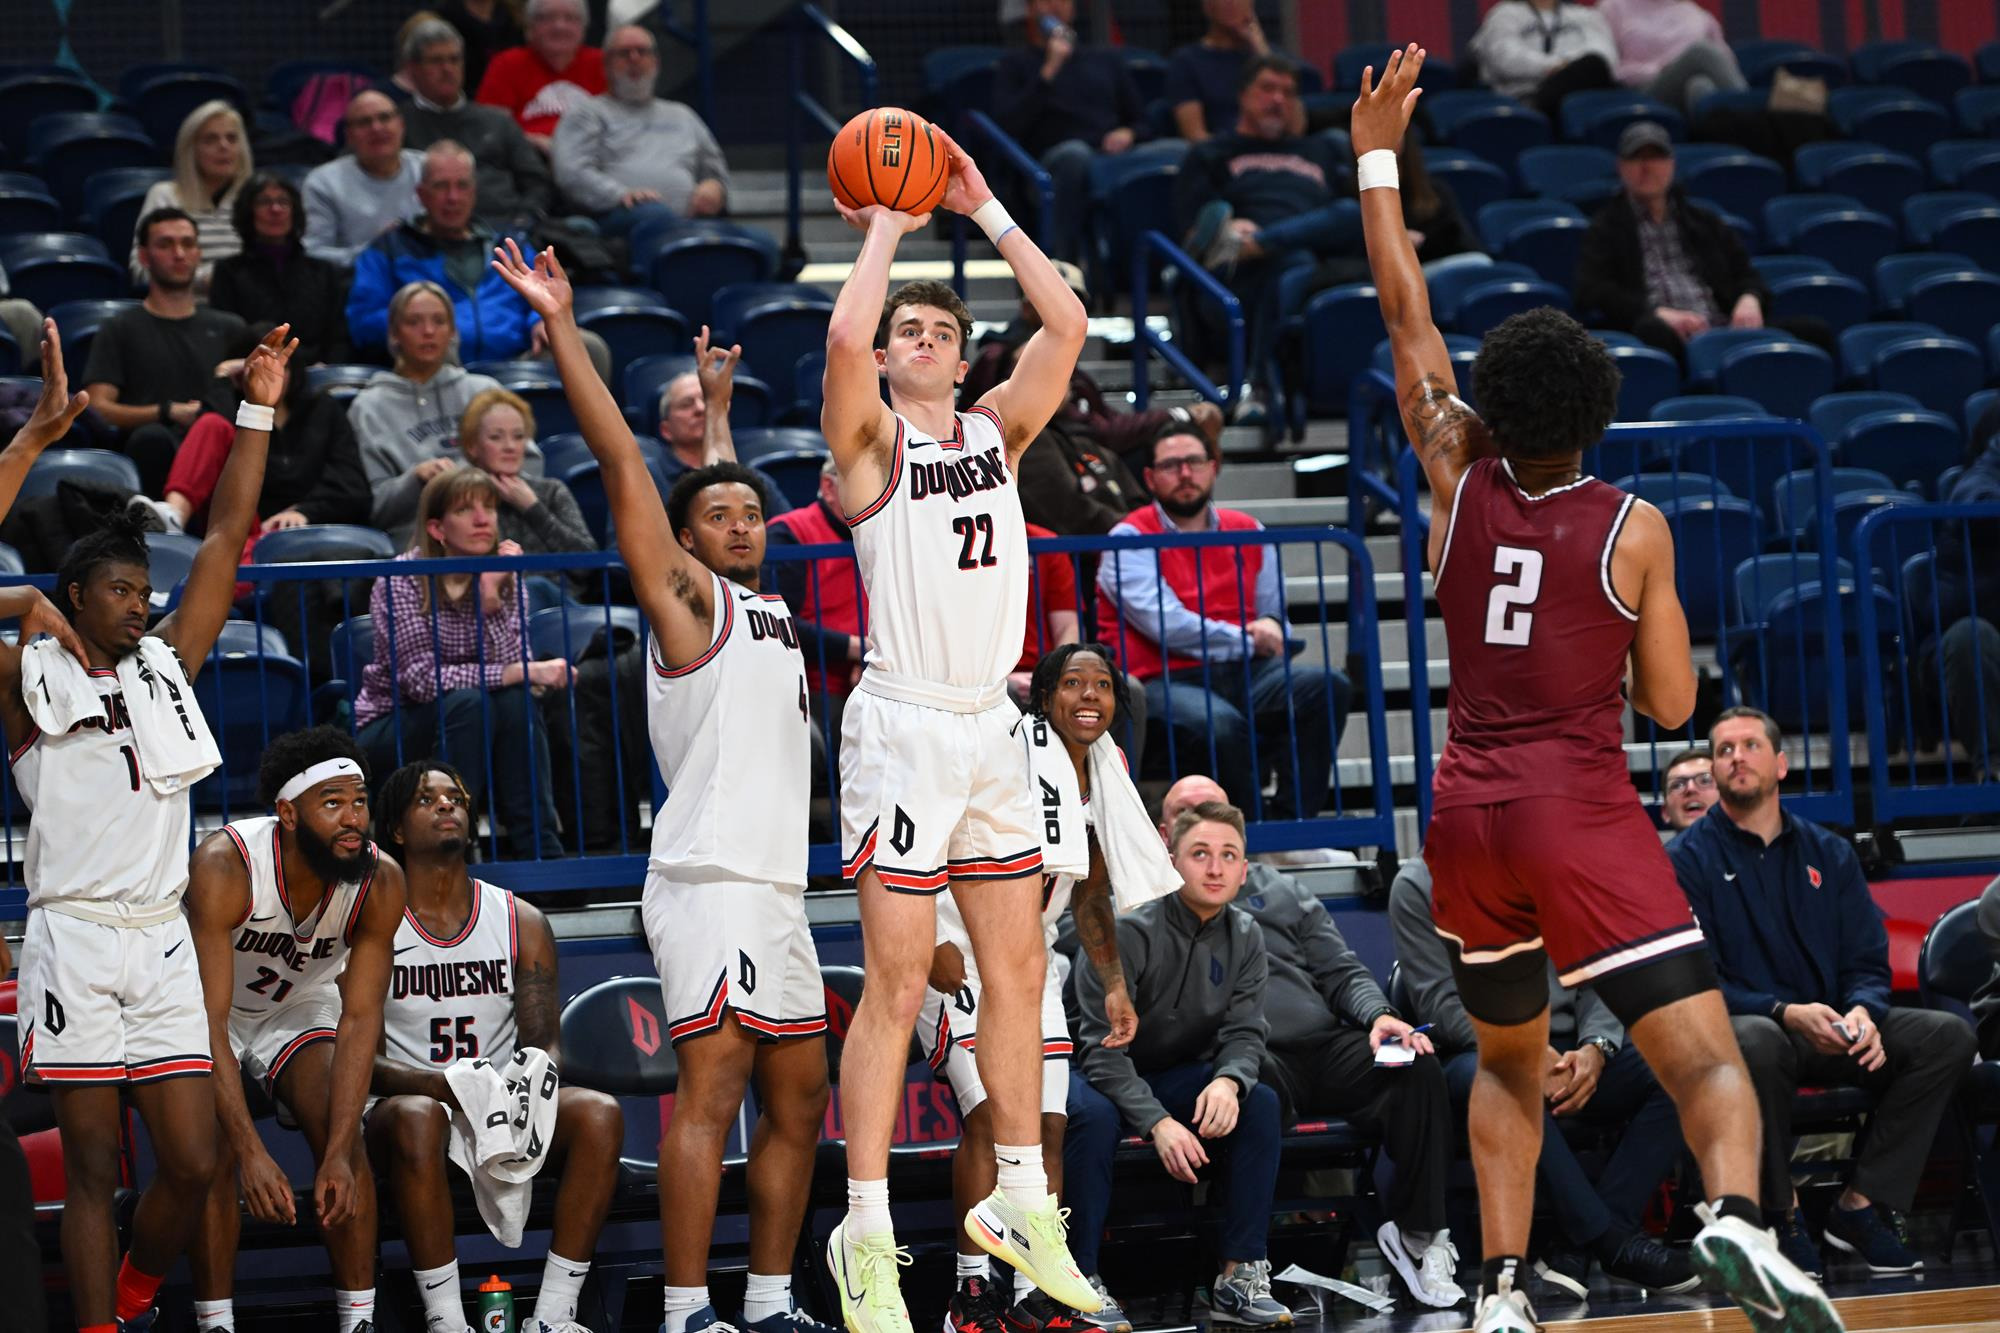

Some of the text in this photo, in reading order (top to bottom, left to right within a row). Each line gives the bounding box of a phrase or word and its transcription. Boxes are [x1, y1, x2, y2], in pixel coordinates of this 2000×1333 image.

[882, 114, 902, 168] ELITE
[952, 513, 997, 571] 22
[1484, 545, 1544, 647] 2
[120, 745, 141, 792] 1
[245, 965, 295, 1003] 21
[392, 959, 509, 1002] DUQUESNE
[430, 1016, 479, 1063] 55
